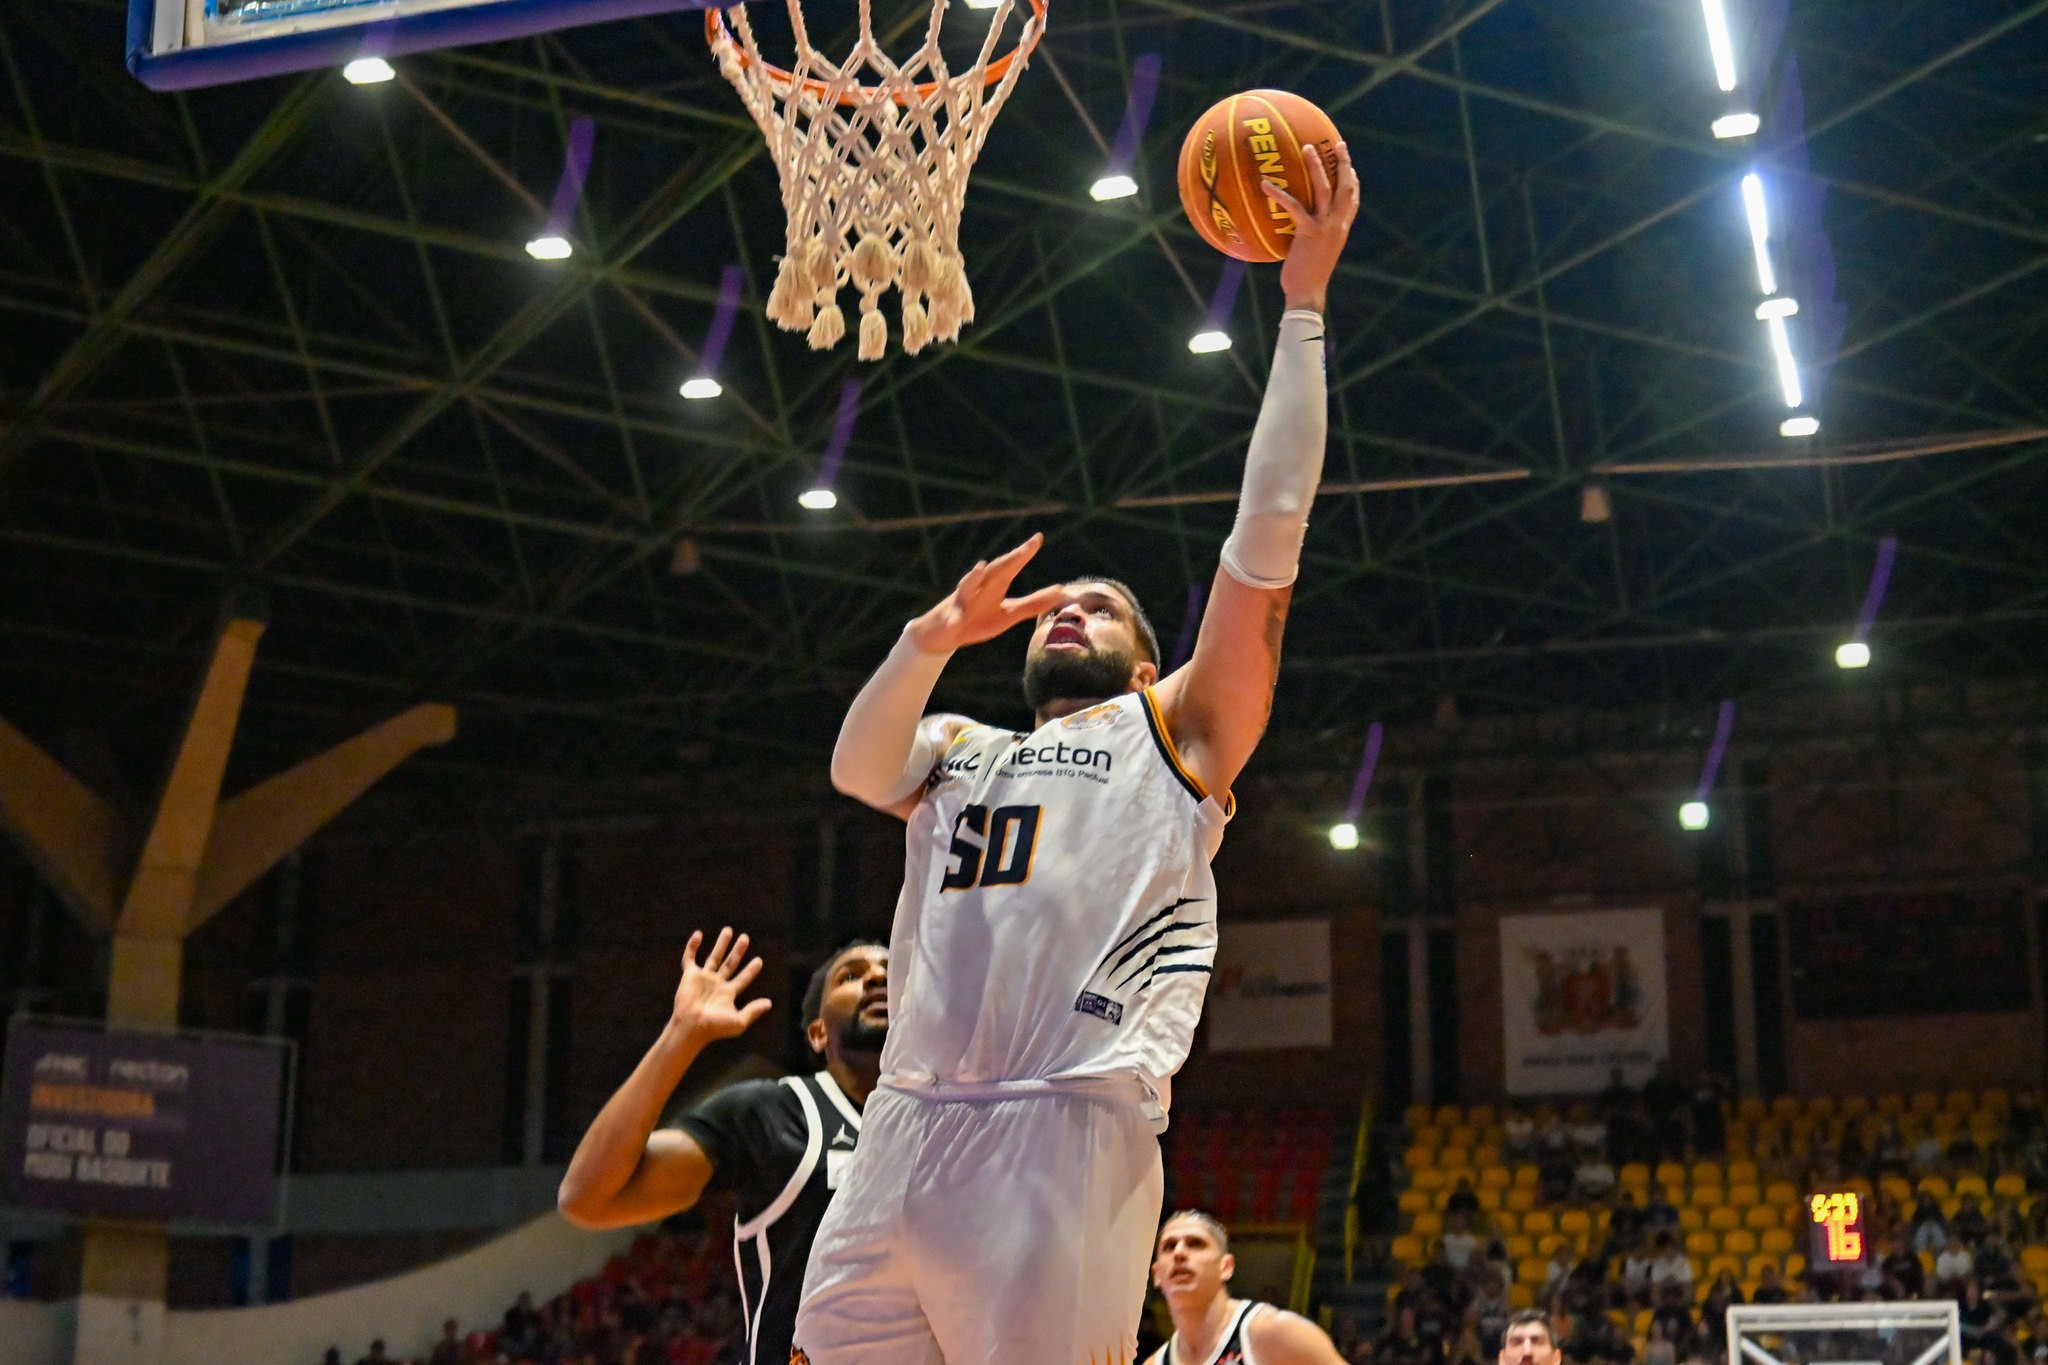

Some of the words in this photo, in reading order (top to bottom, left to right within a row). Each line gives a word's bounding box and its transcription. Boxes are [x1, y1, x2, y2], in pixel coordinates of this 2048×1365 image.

[1243, 118, 1299, 237] PENALTY
[939, 803, 1045, 894] 50
[1824, 1214, 1862, 1261] 16
